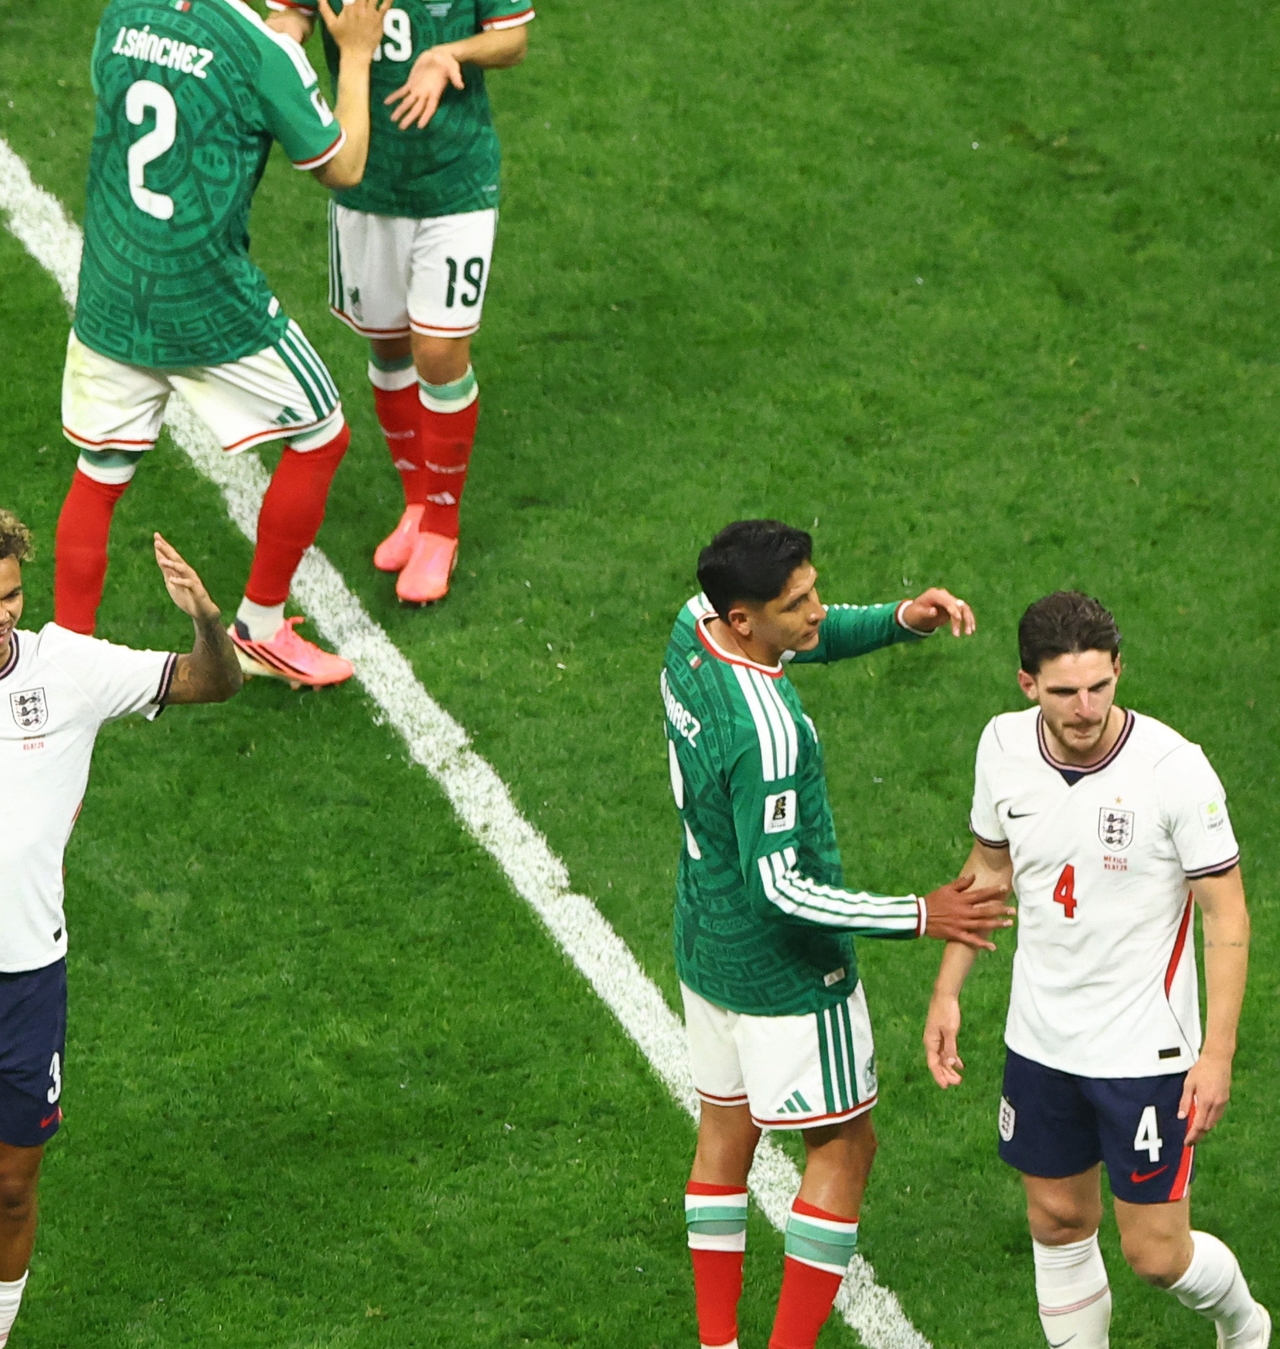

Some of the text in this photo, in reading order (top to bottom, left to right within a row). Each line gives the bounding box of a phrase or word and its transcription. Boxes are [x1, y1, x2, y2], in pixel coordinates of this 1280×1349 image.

[112, 24, 214, 79] J.SÁNCHEZ
[373, 8, 413, 62] 9
[125, 80, 177, 220] 2
[446, 256, 484, 308] 19
[1103, 855, 1128, 864] MEXICO
[1053, 863, 1078, 919] 4
[47, 1051, 62, 1104] 3
[1134, 1105, 1163, 1163] 4
